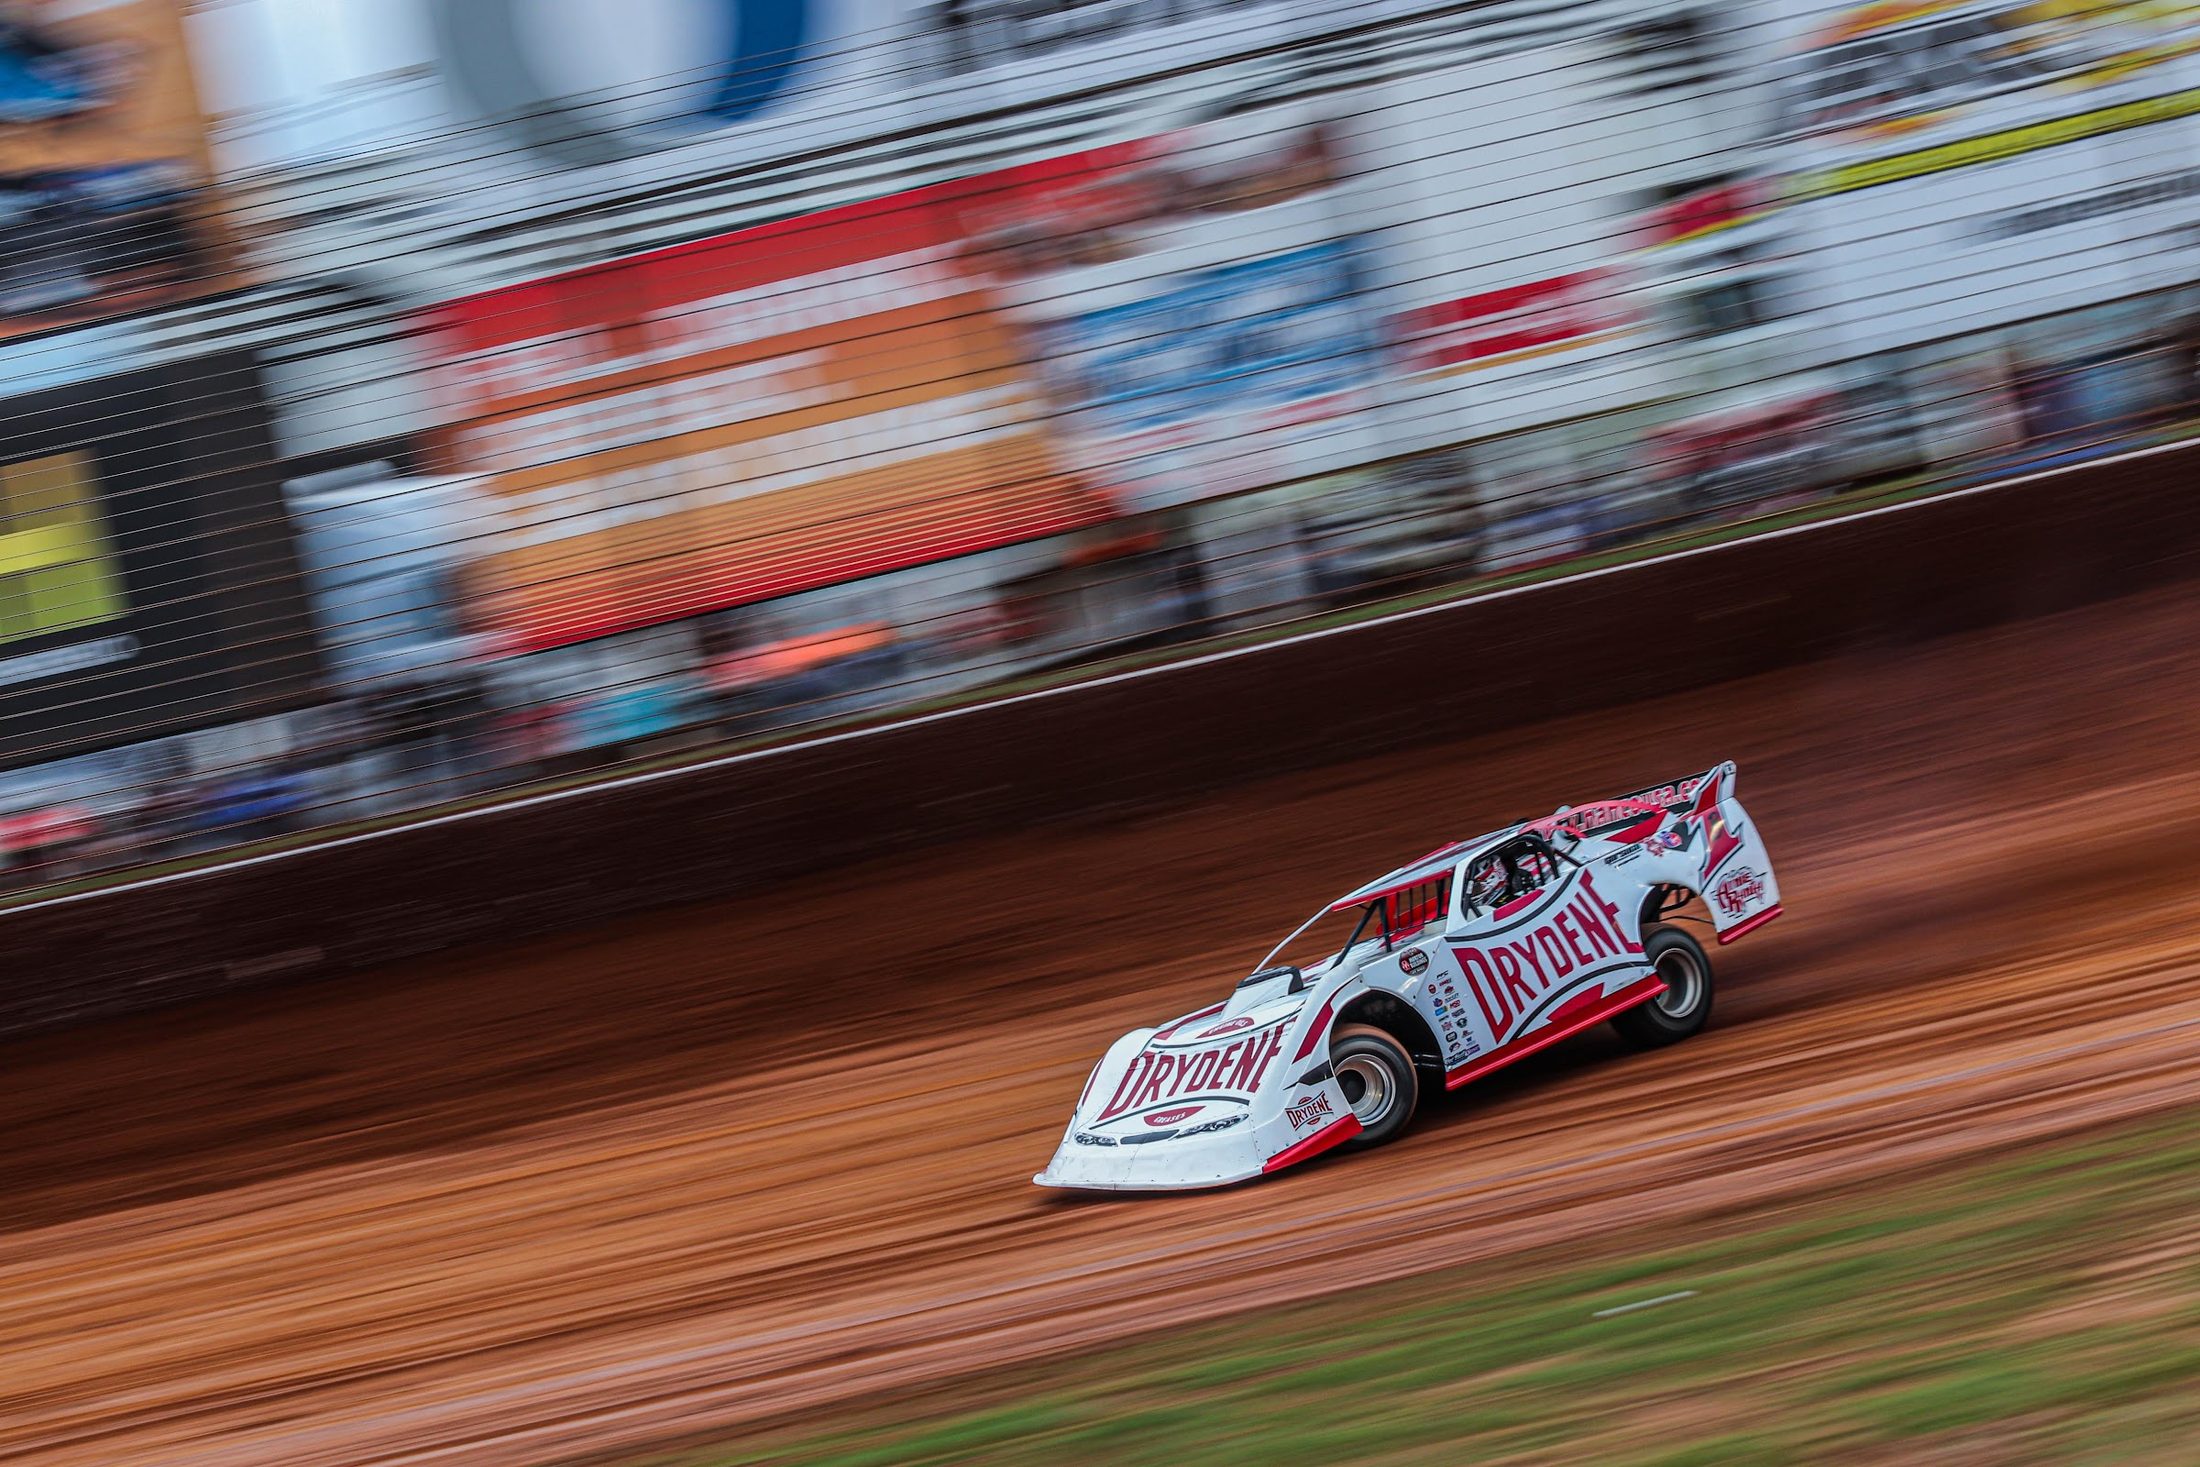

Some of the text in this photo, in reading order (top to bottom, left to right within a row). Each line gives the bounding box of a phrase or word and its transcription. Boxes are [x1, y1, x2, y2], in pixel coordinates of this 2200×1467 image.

[1451, 868, 1645, 1045] DRYDENE
[1096, 1015, 1297, 1122] DRYDENE
[1153, 1111, 1187, 1124] GREASES
[1285, 1092, 1333, 1129] DRYDENE
